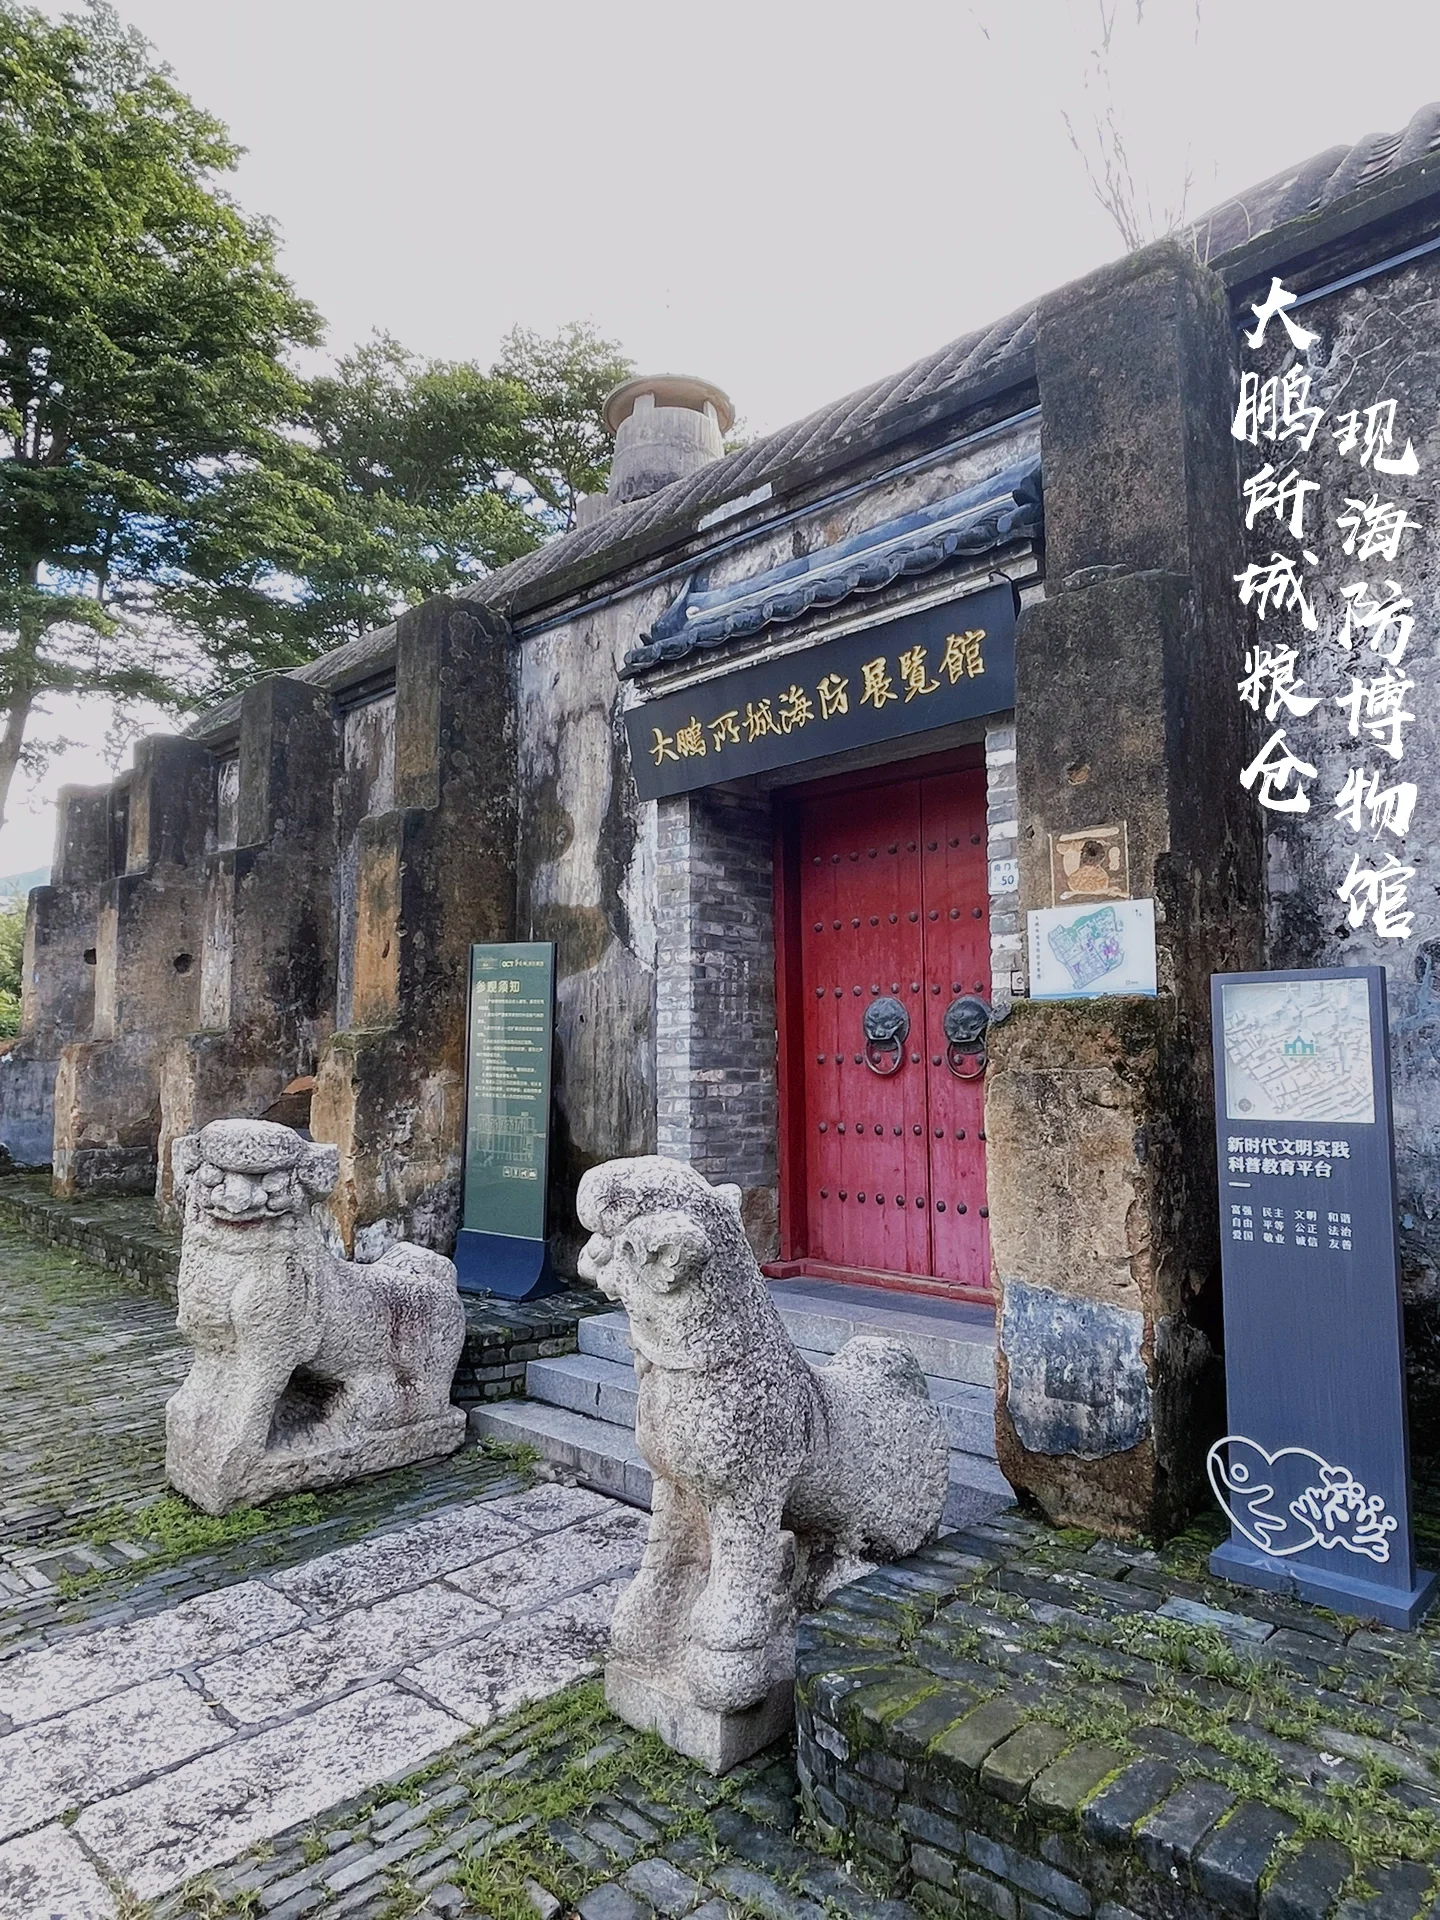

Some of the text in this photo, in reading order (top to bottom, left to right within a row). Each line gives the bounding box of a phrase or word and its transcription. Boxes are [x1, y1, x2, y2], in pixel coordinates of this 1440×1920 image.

[1001, 875, 1015, 885] 50
[476, 980, 520, 993] 参观须知
[1227, 1136, 1350, 1159] 新时代文明实践
[1228, 1156, 1332, 1178] 科普教育平台
[1230, 1204, 1351, 1224] 富强 民主 文明 和谐
[1232, 1217, 1352, 1237] 自由 平等 公正 法治
[1232, 1230, 1352, 1251] 爱国 敬业 诚信 友善
